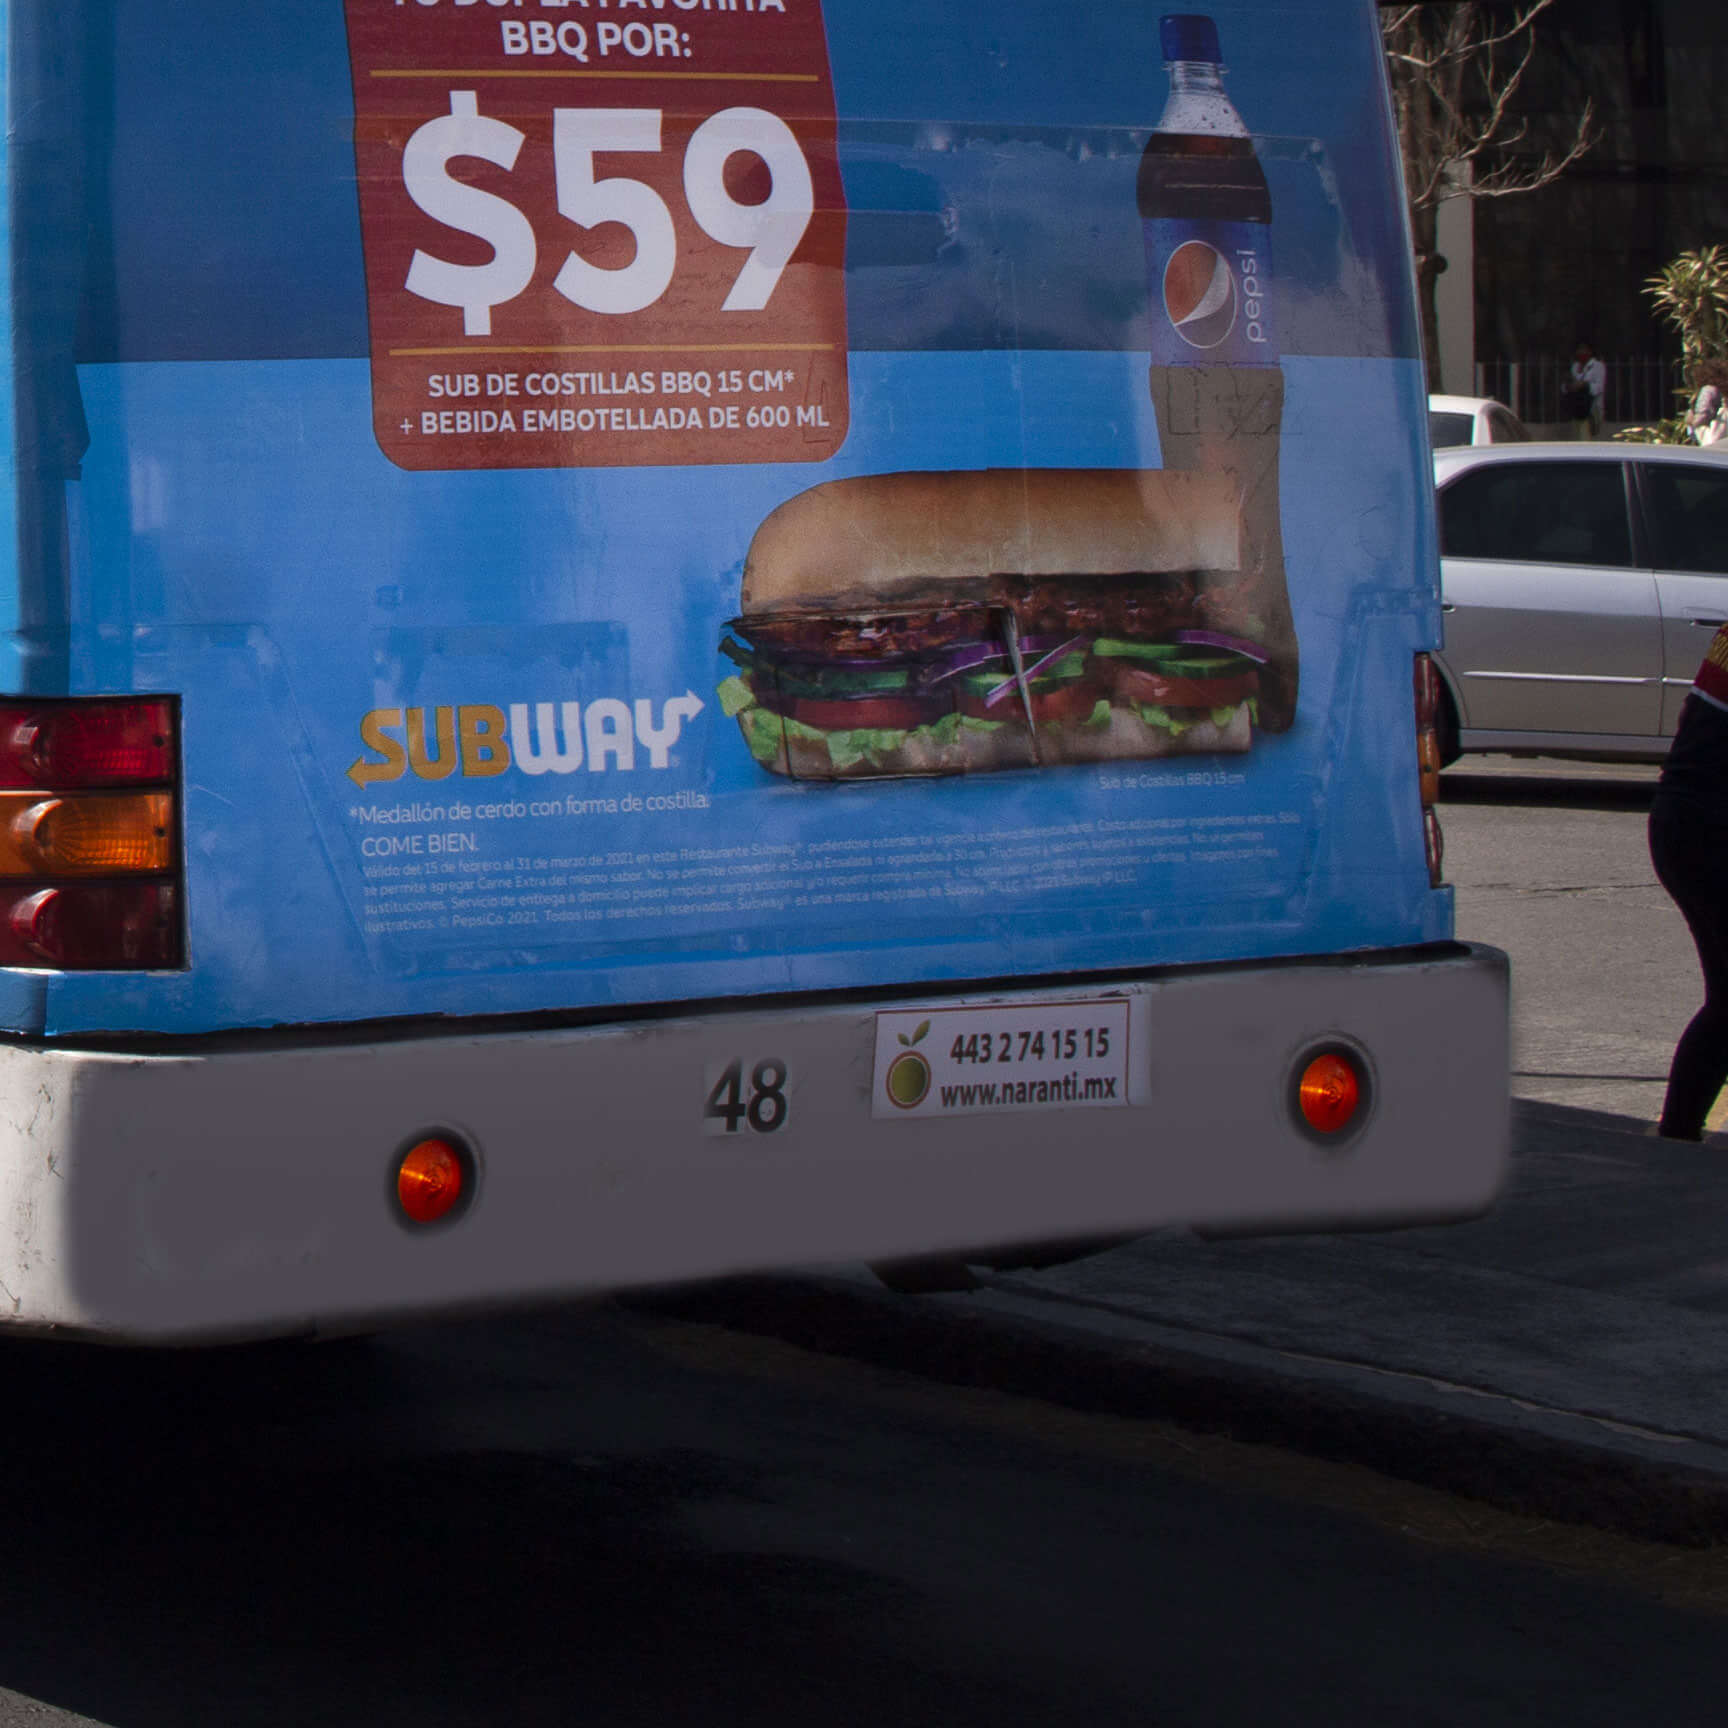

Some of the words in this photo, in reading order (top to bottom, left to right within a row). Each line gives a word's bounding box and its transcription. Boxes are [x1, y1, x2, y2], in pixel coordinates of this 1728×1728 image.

[500, 20, 589, 63] BBQ
[596, 21, 692, 58] POR:
[401, 89, 816, 338] $59
[1239, 248, 1268, 343] pepsi
[428, 373, 479, 398] SUB
[485, 373, 520, 397] DE
[525, 371, 656, 395] COSTILLAS
[661, 371, 712, 398] BBQ
[717, 370, 743, 393] 15
[421, 410, 517, 434] BEBIDA
[522, 407, 703, 432] EMBOTELLADA
[709, 406, 741, 430] DE
[745, 405, 791, 429] 600
[795, 404, 831, 428] ML
[345, 688, 705, 790] SUBWAY
[448, 804, 472, 822] de
[475, 801, 528, 820] cerdo
[530, 800, 562, 818] con
[564, 793, 618, 817] forma
[620, 793, 643, 814] de
[646, 790, 711, 813] costilla.
[360, 834, 425, 858] COME
[428, 832, 480, 854] BIEN.
[949, 1032, 992, 1065] 443
[998, 1032, 1012, 1062] 2
[1016, 1030, 1046, 1062] 74
[1052, 1029, 1077, 1060] 15
[1084, 1027, 1110, 1058] 15
[703, 1056, 788, 1135] 48
[940, 1071, 1117, 1108] www.naranti.mx
